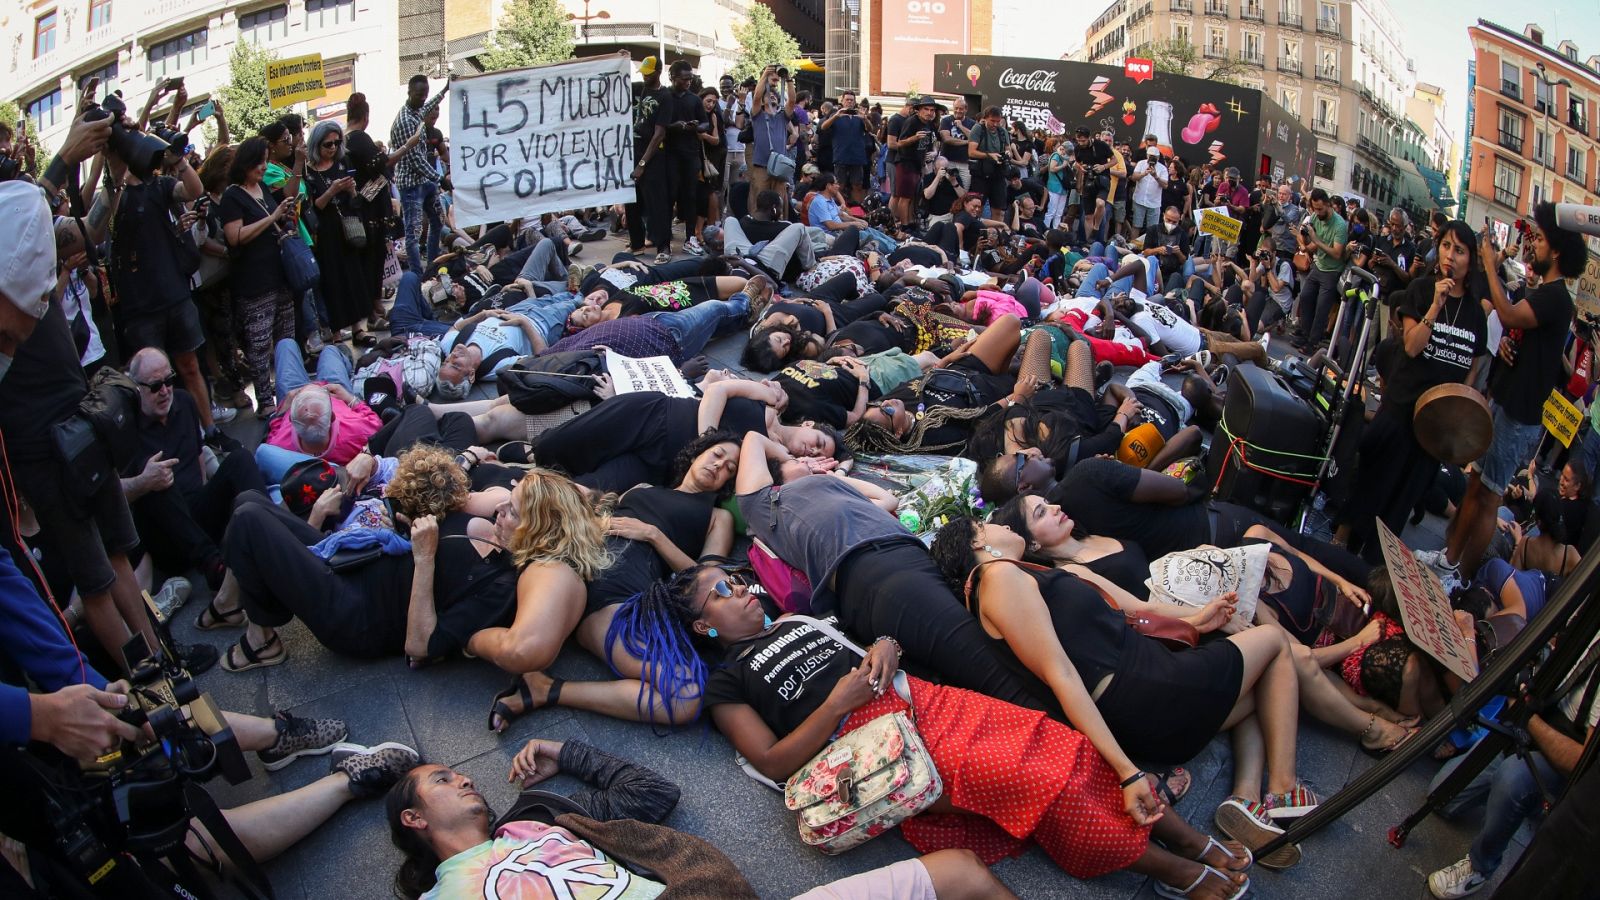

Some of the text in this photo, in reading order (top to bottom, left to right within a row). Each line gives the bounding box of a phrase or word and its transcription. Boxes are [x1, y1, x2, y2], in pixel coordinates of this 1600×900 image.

[907, 0, 945, 14] 010
[279, 62, 302, 77] inhumana
[303, 59, 321, 72] frontera
[998, 67, 1059, 93] Coca-Cola
[270, 84, 286, 99] revela
[287, 80, 304, 95] nuestro
[461, 71, 632, 137] 45 MUERTOS
[1001, 105, 1052, 121] #ZERO
[1006, 98, 1049, 108] ZERO AZÚCAR
[461, 124, 633, 171] POR VIOLENCIA
[480, 158, 636, 210] POLICIAL
[1457, 354, 1473, 366] socia
[1434, 611, 1457, 658] VIDAS
[764, 647, 803, 684] Permanente
[806, 640, 818, 651] sin
[777, 647, 836, 701] por justicia
